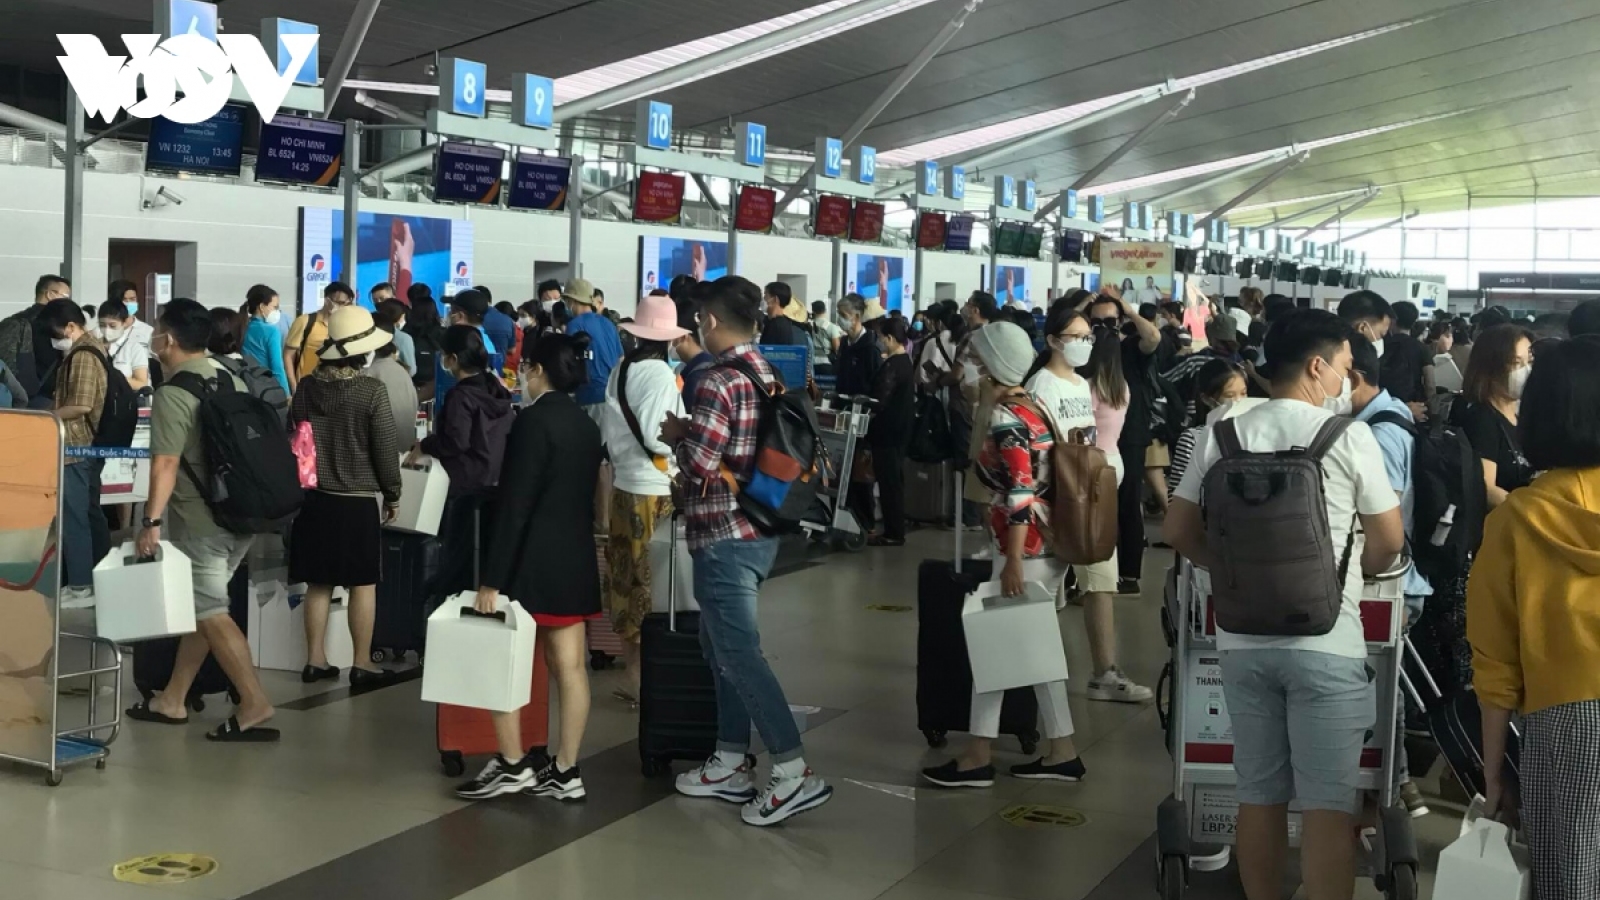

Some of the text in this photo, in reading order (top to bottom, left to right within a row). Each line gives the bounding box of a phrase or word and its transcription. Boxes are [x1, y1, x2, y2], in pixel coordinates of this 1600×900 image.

[463, 72, 477, 104] 8
[534, 87, 545, 115] 9
[652, 111, 669, 140] 10
[158, 142, 192, 154] VN 1232
[212, 147, 232, 157] 13:45
[307, 139, 326, 150] MINH
[749, 133, 762, 158] 11
[828, 147, 840, 170] 12
[863, 154, 874, 176] 13
[927, 168, 937, 188] 14
[955, 173, 964, 193] 15
[1202, 813, 1232, 822] LASER
[1202, 821, 1226, 833] LBP
